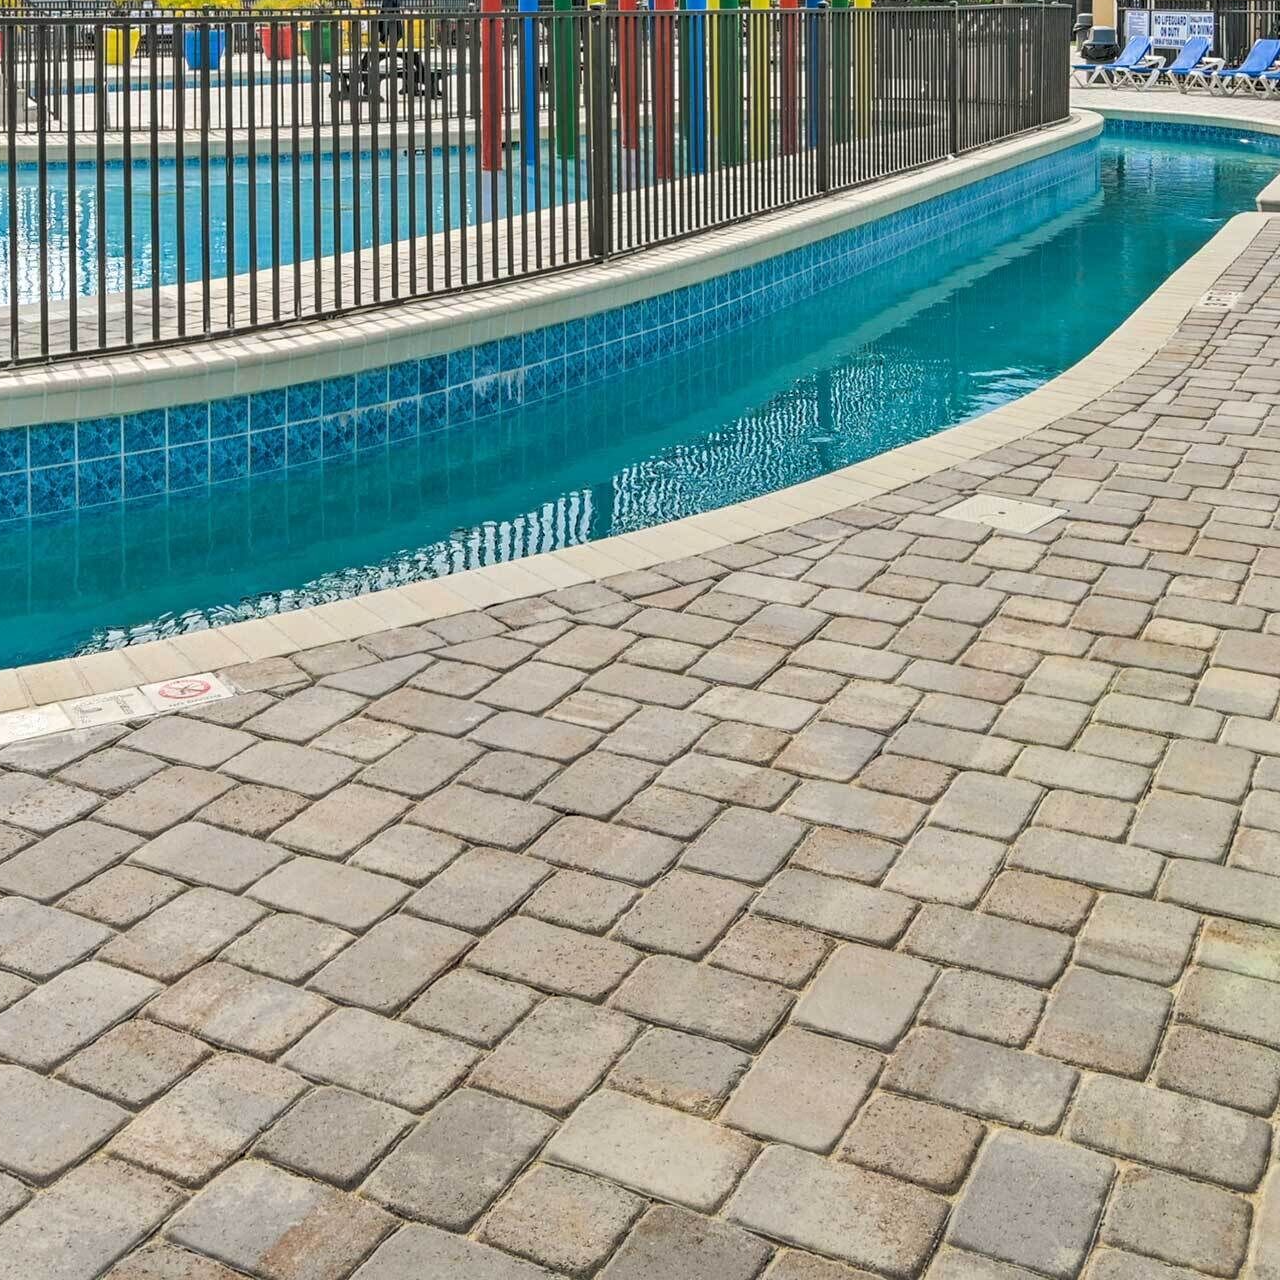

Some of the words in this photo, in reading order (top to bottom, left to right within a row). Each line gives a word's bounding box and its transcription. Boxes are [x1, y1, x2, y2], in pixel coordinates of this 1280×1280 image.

[1154, 15, 1161, 25] NO
[1162, 15, 1187, 26] LIFEGUARD
[1160, 26, 1167, 37] ON
[1168, 26, 1180, 37] DUTY
